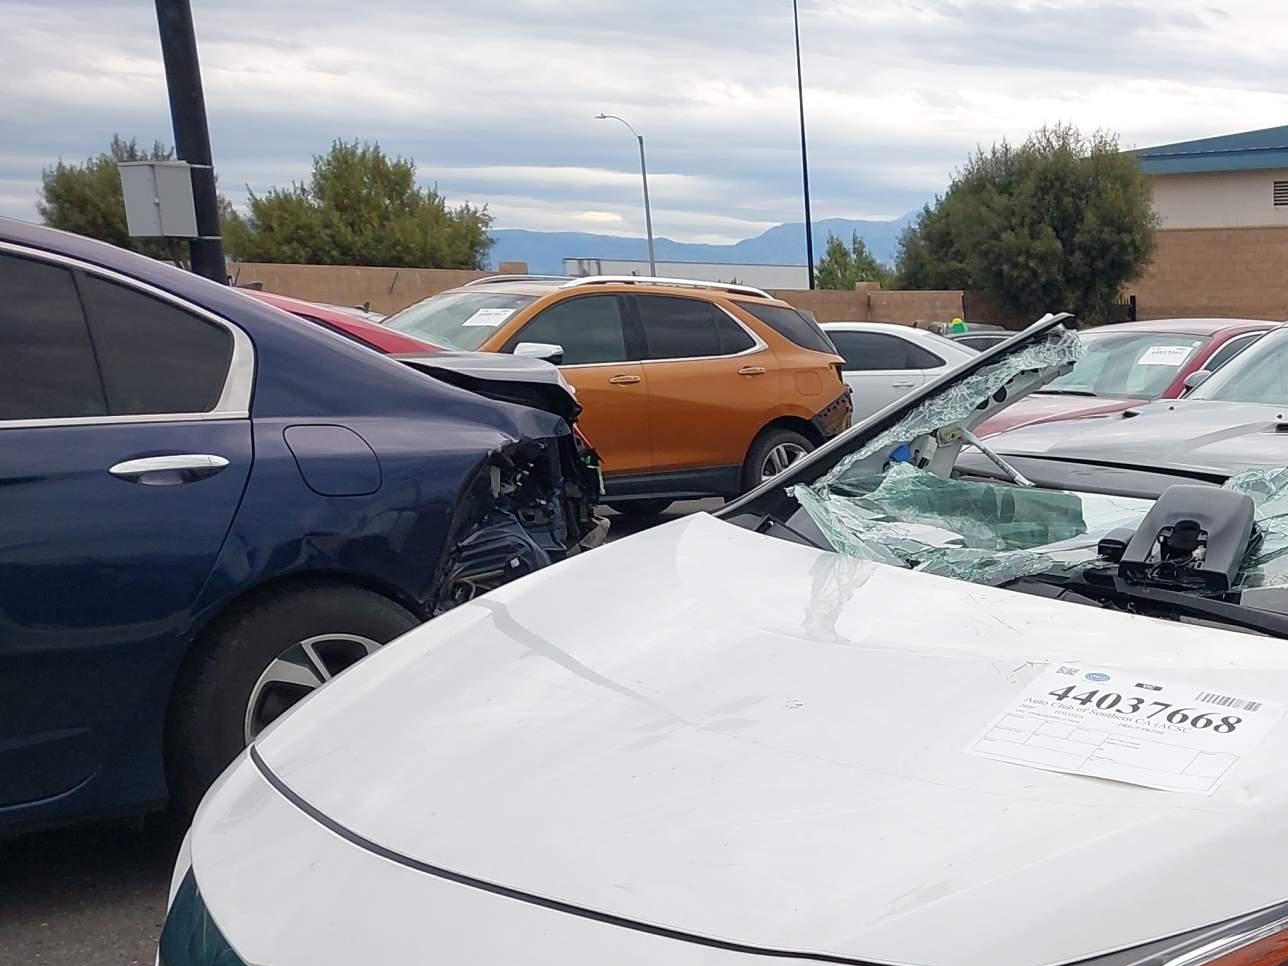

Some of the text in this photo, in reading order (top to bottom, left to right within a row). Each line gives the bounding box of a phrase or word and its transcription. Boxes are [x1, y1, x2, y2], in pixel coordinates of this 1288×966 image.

[1023, 697, 1049, 706] Auto
[1050, 701, 1075, 711] Club
[1088, 708, 1132, 722] Southern
[1135, 718, 1151, 726] CA
[1048, 685, 1243, 734] 44037668
